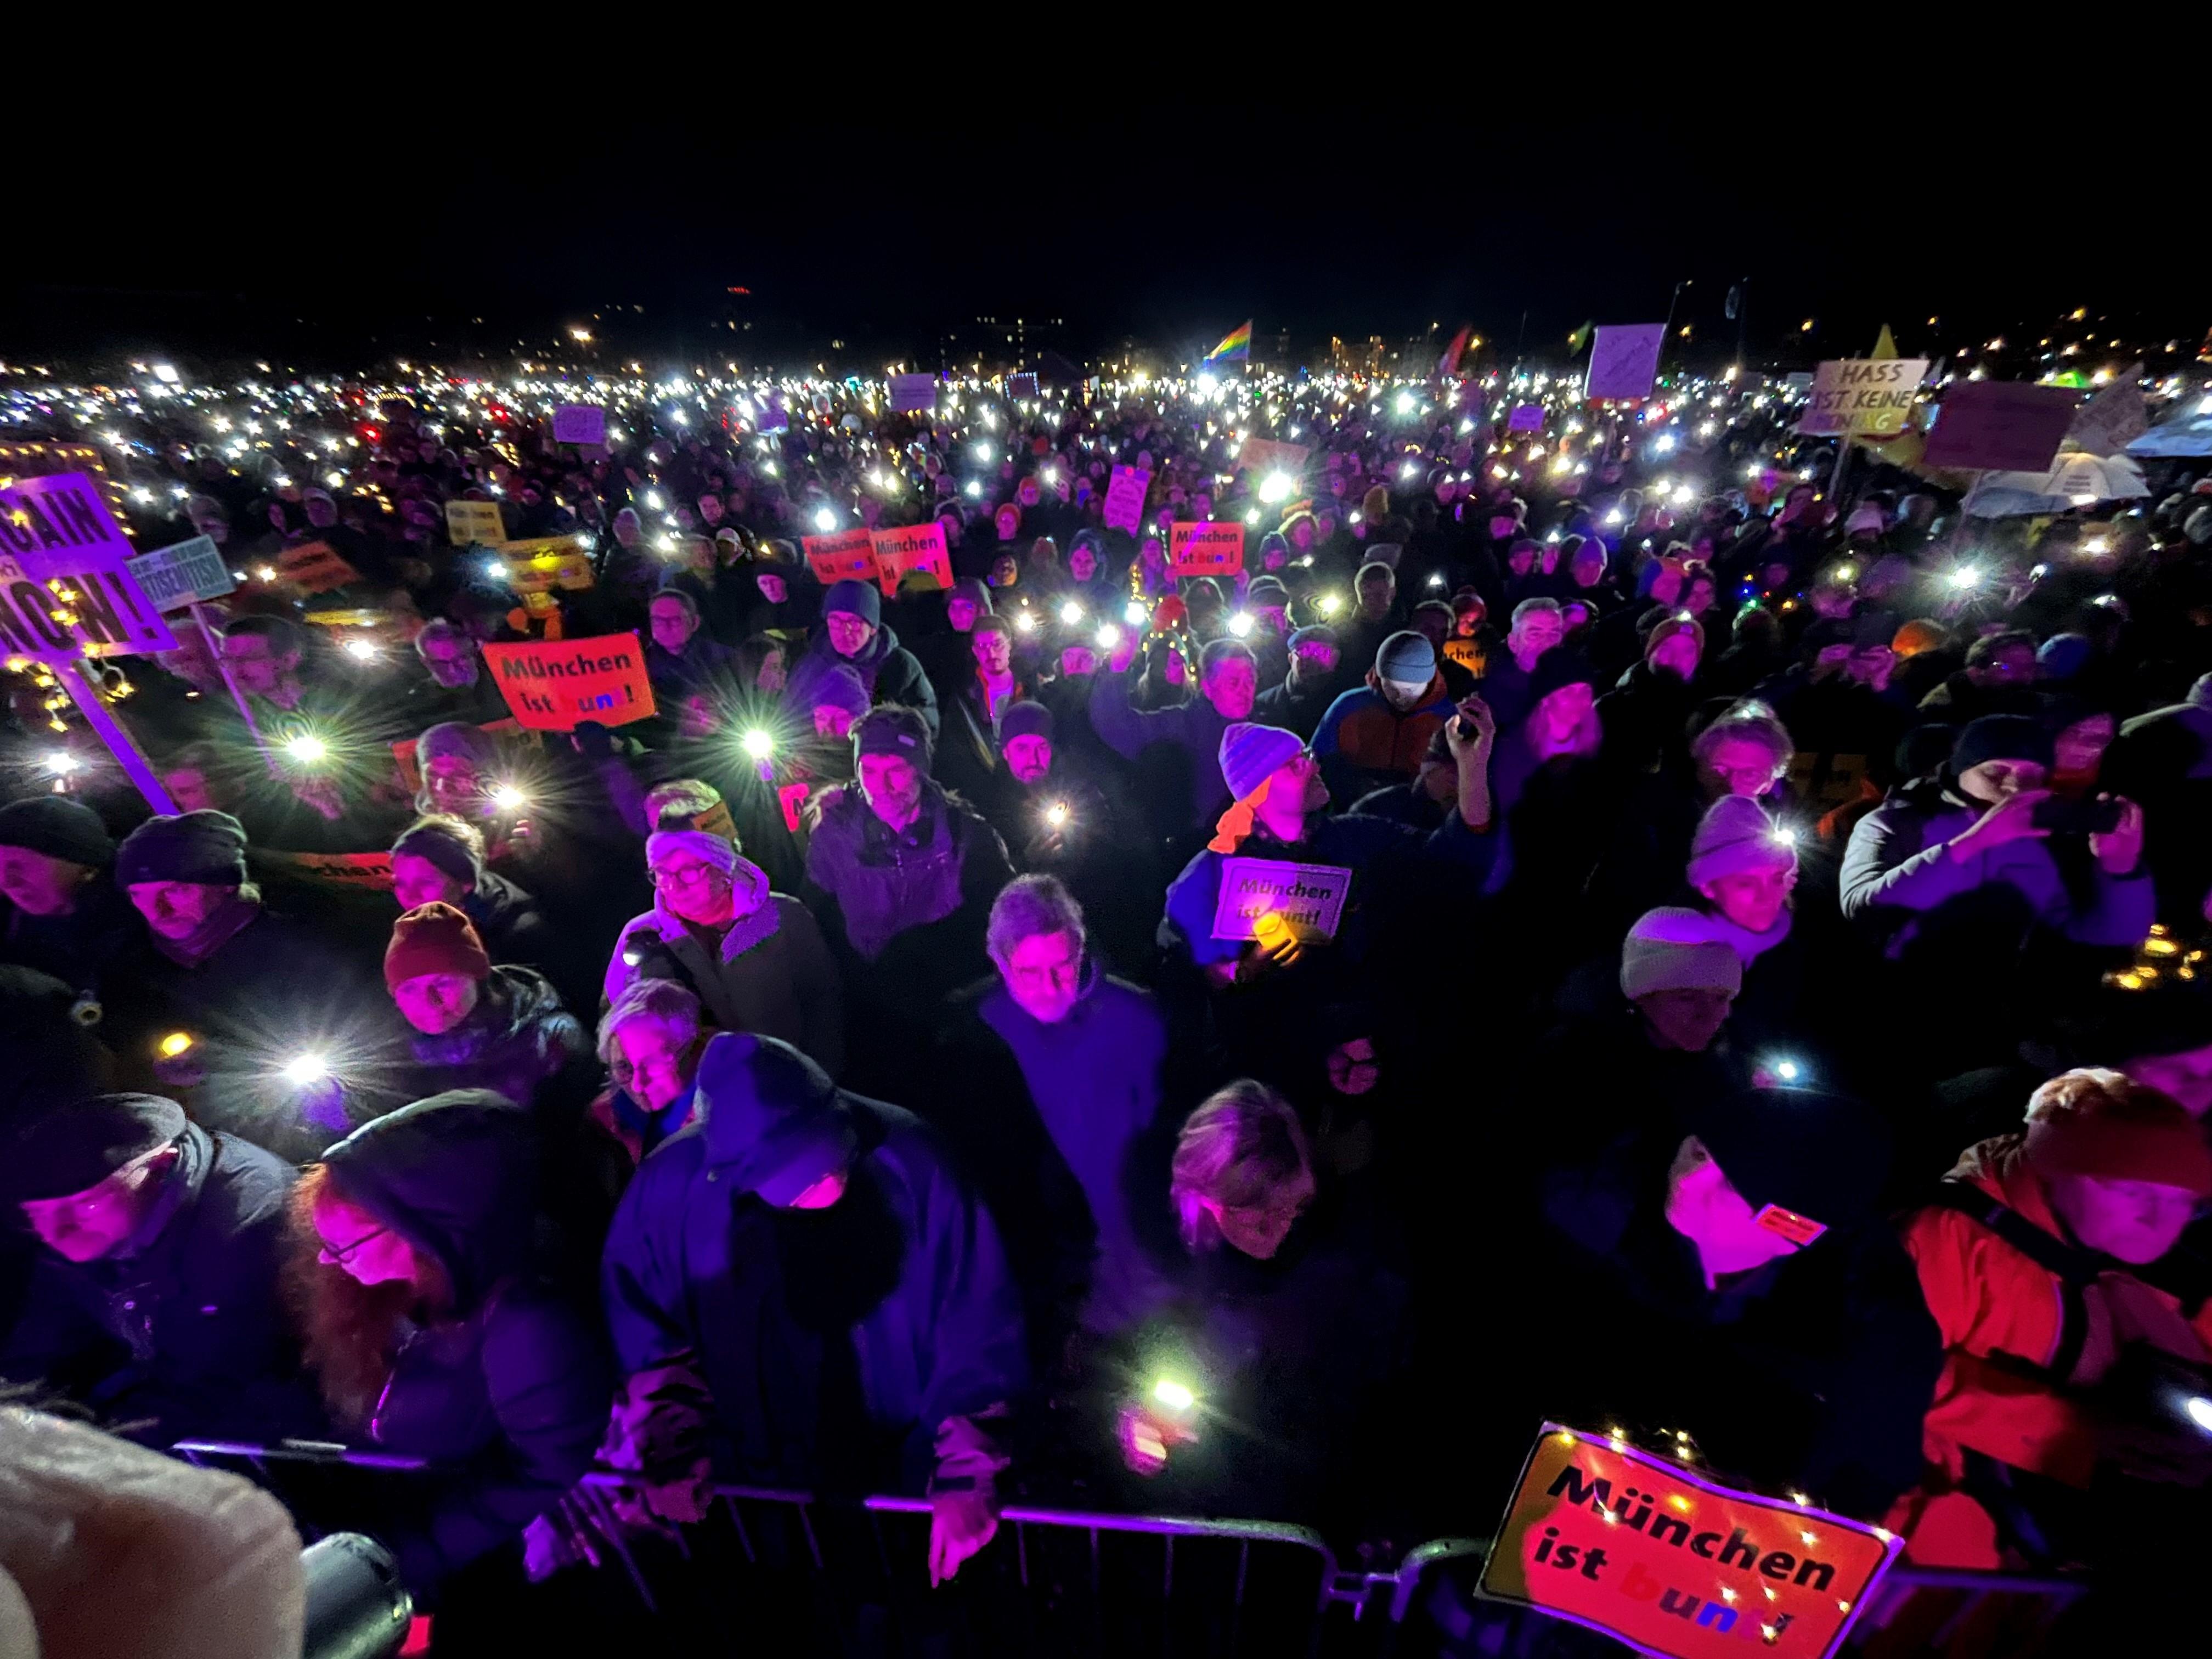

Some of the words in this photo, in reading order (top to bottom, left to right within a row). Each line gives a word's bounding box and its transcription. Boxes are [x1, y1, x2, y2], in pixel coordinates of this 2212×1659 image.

[1839, 363, 1904, 384] HASS
[1813, 390, 1851, 410] IST
[1852, 390, 1912, 410] KEINE
[0, 486, 112, 553] GAIN
[876, 535, 938, 555] München
[1176, 531, 1238, 543] München
[500, 653, 631, 678] München
[520, 693, 555, 714] ist
[1238, 878, 1331, 901] München
[1237, 904, 1260, 919] ist
[1546, 1465, 1836, 1593] München
[1533, 1527, 1608, 1582] ist
